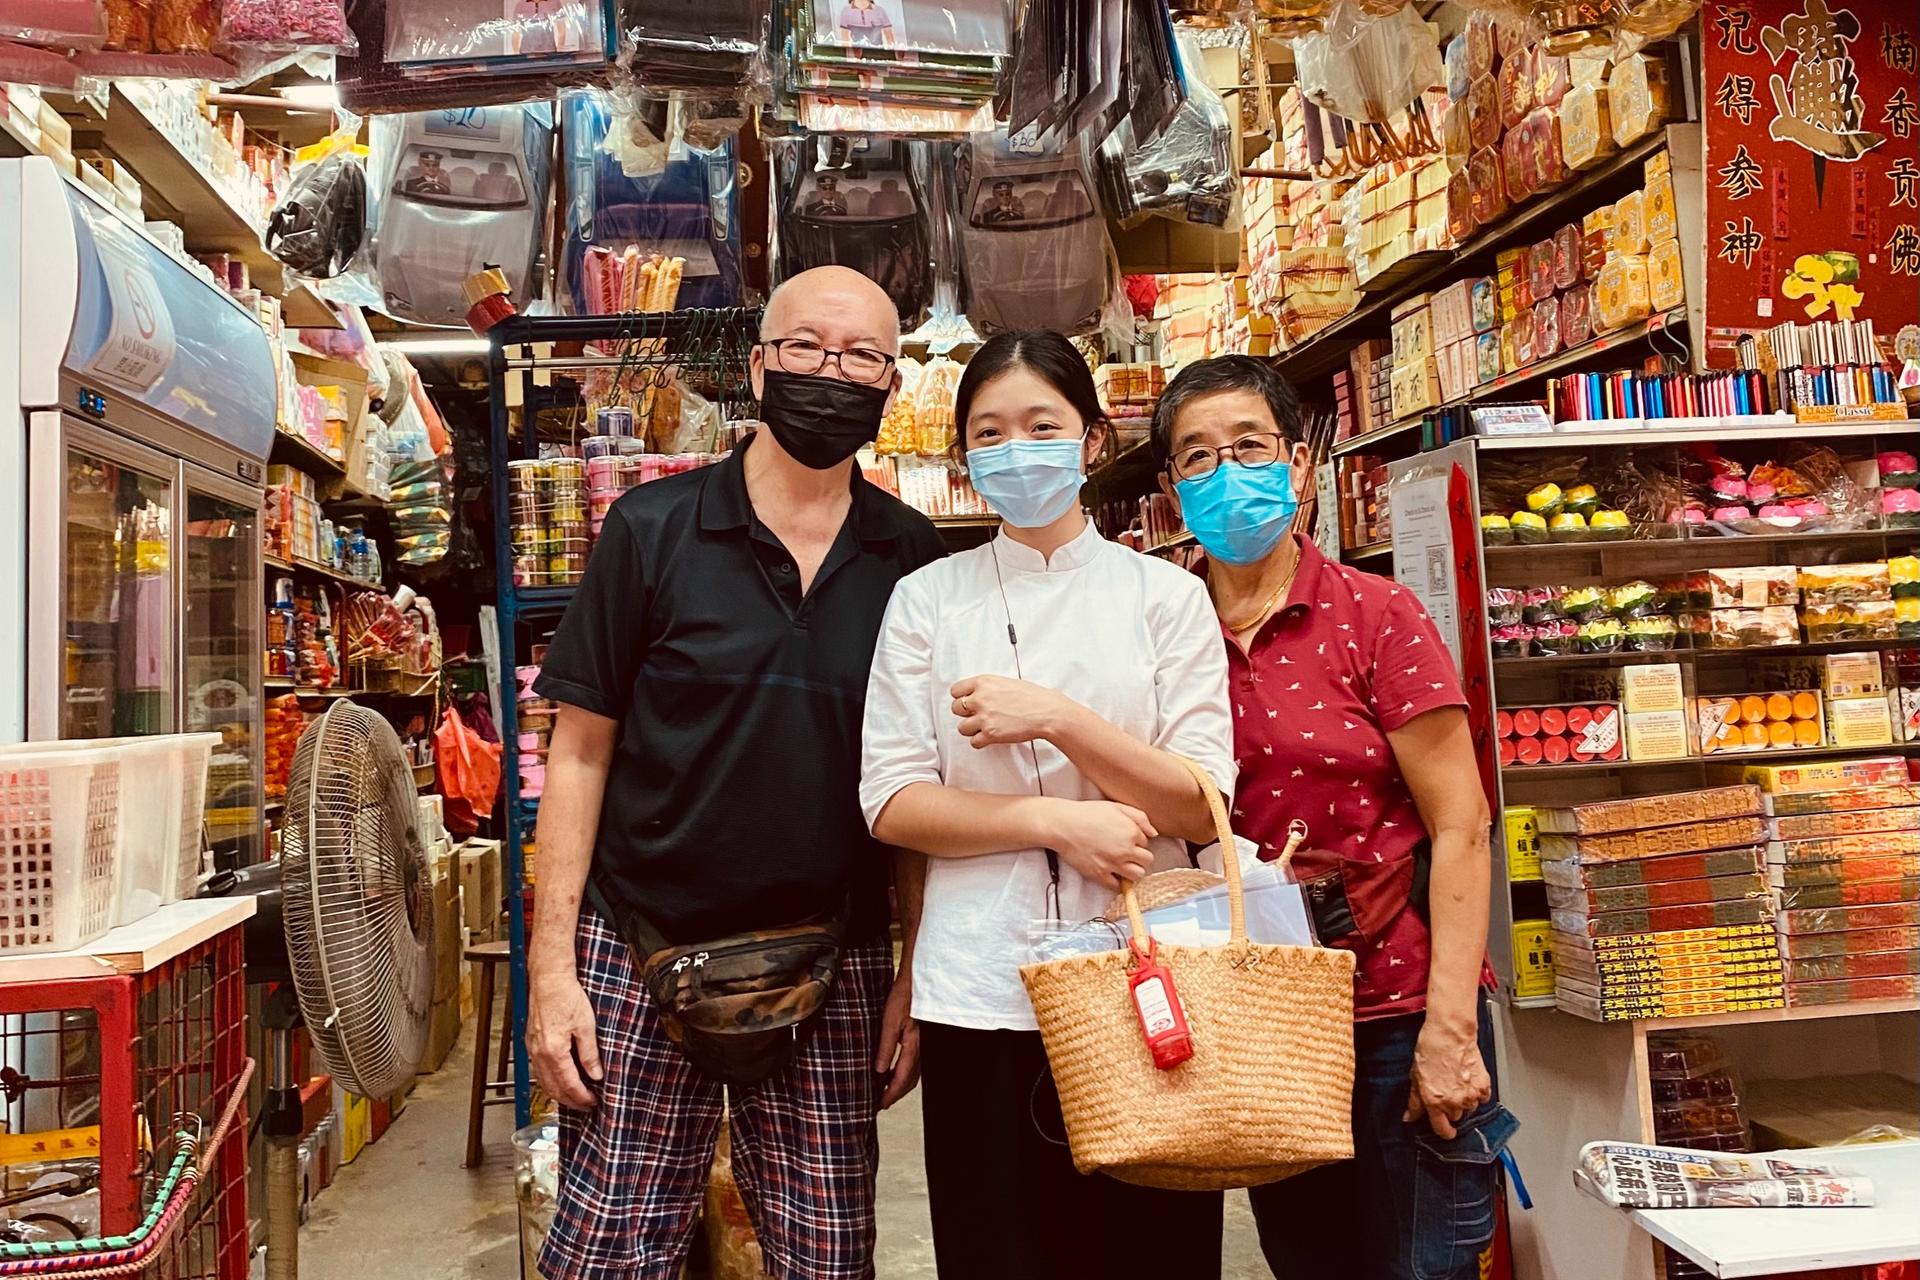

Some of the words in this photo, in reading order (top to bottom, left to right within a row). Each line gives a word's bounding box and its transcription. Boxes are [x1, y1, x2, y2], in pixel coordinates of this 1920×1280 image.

[1714, 5, 1764, 270] 记得参神
[1835, 406, 1873, 417] Classic
